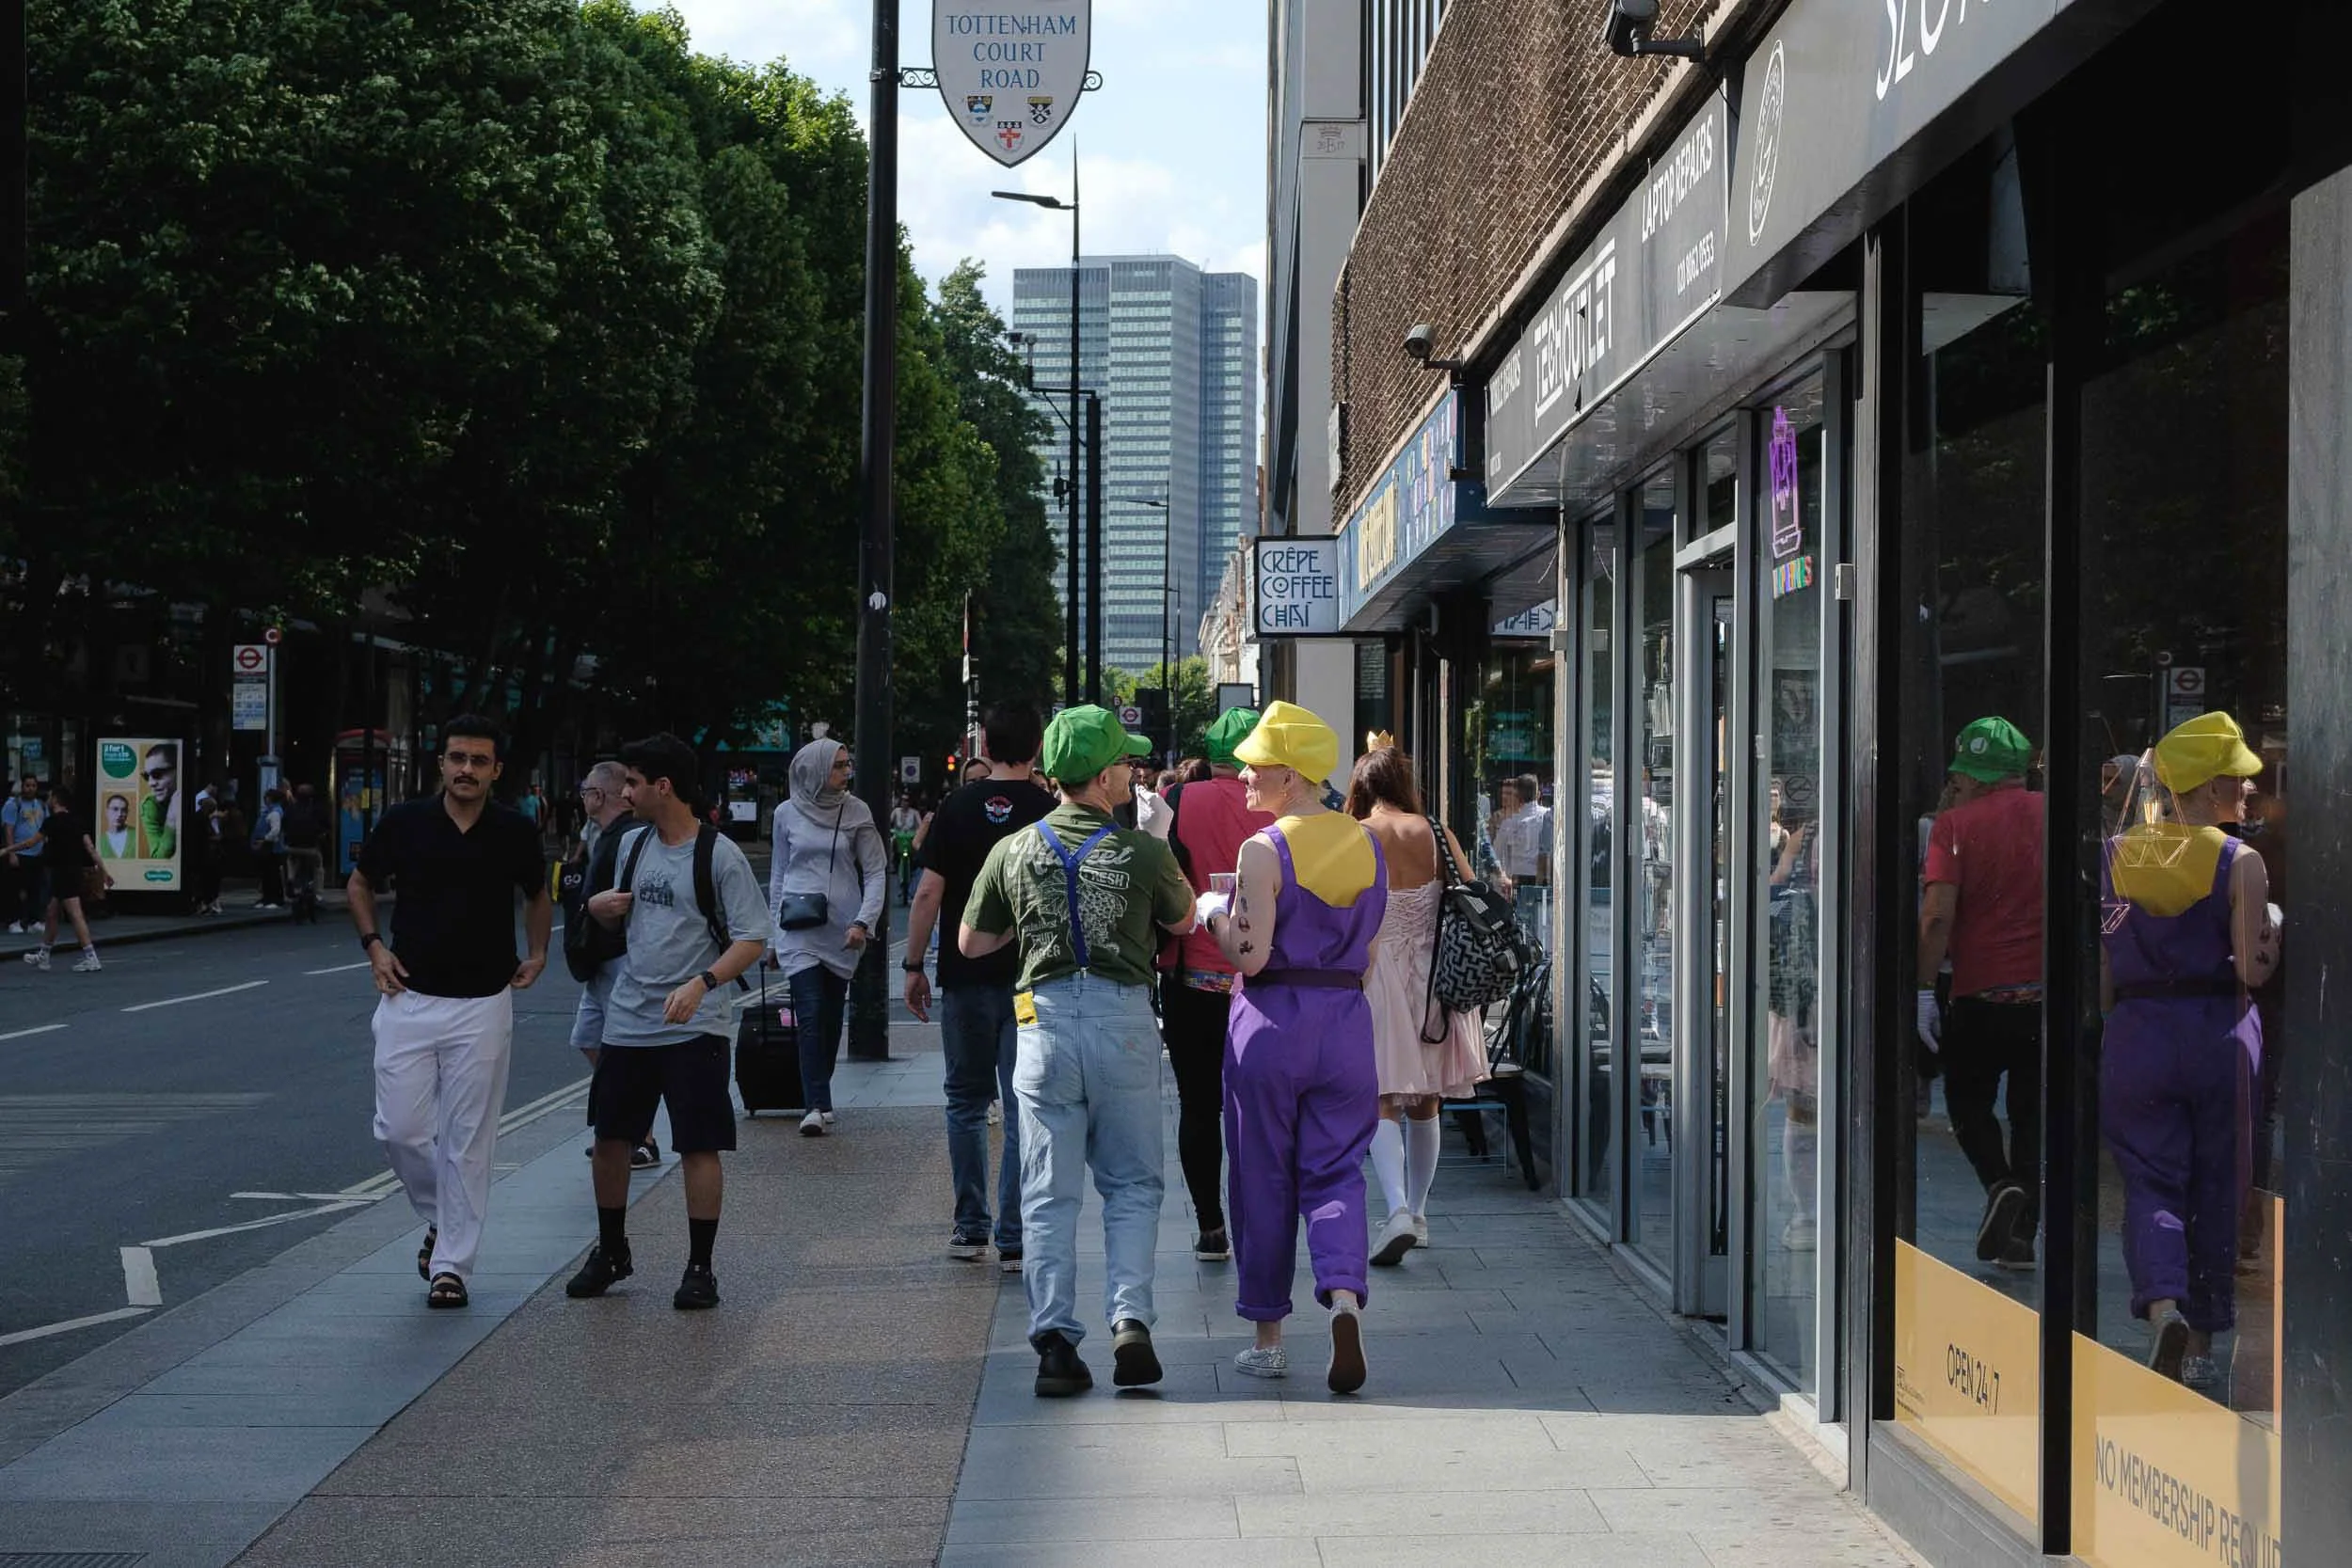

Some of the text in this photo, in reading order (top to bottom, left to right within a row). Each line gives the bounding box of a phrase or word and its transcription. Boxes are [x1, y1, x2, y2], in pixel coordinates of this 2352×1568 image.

[946, 15, 1076, 35] TOTTENHAM
[974, 42, 1046, 62] COURT
[981, 69, 1040, 88] ROAD
[1642, 114, 1713, 243] LAPTOP REPAIRS
[1262, 546, 1321, 573] CRÊPE
[1262, 577, 1333, 598] COFFEE
[564, 873, 582, 886] GO
[1081, 867, 1124, 888] FRESH
[1947, 1342, 1974, 1399] OPEN
[2095, 1432, 2116, 1491] NO
[2120, 1447, 2215, 1551] MEMBERSHIP
